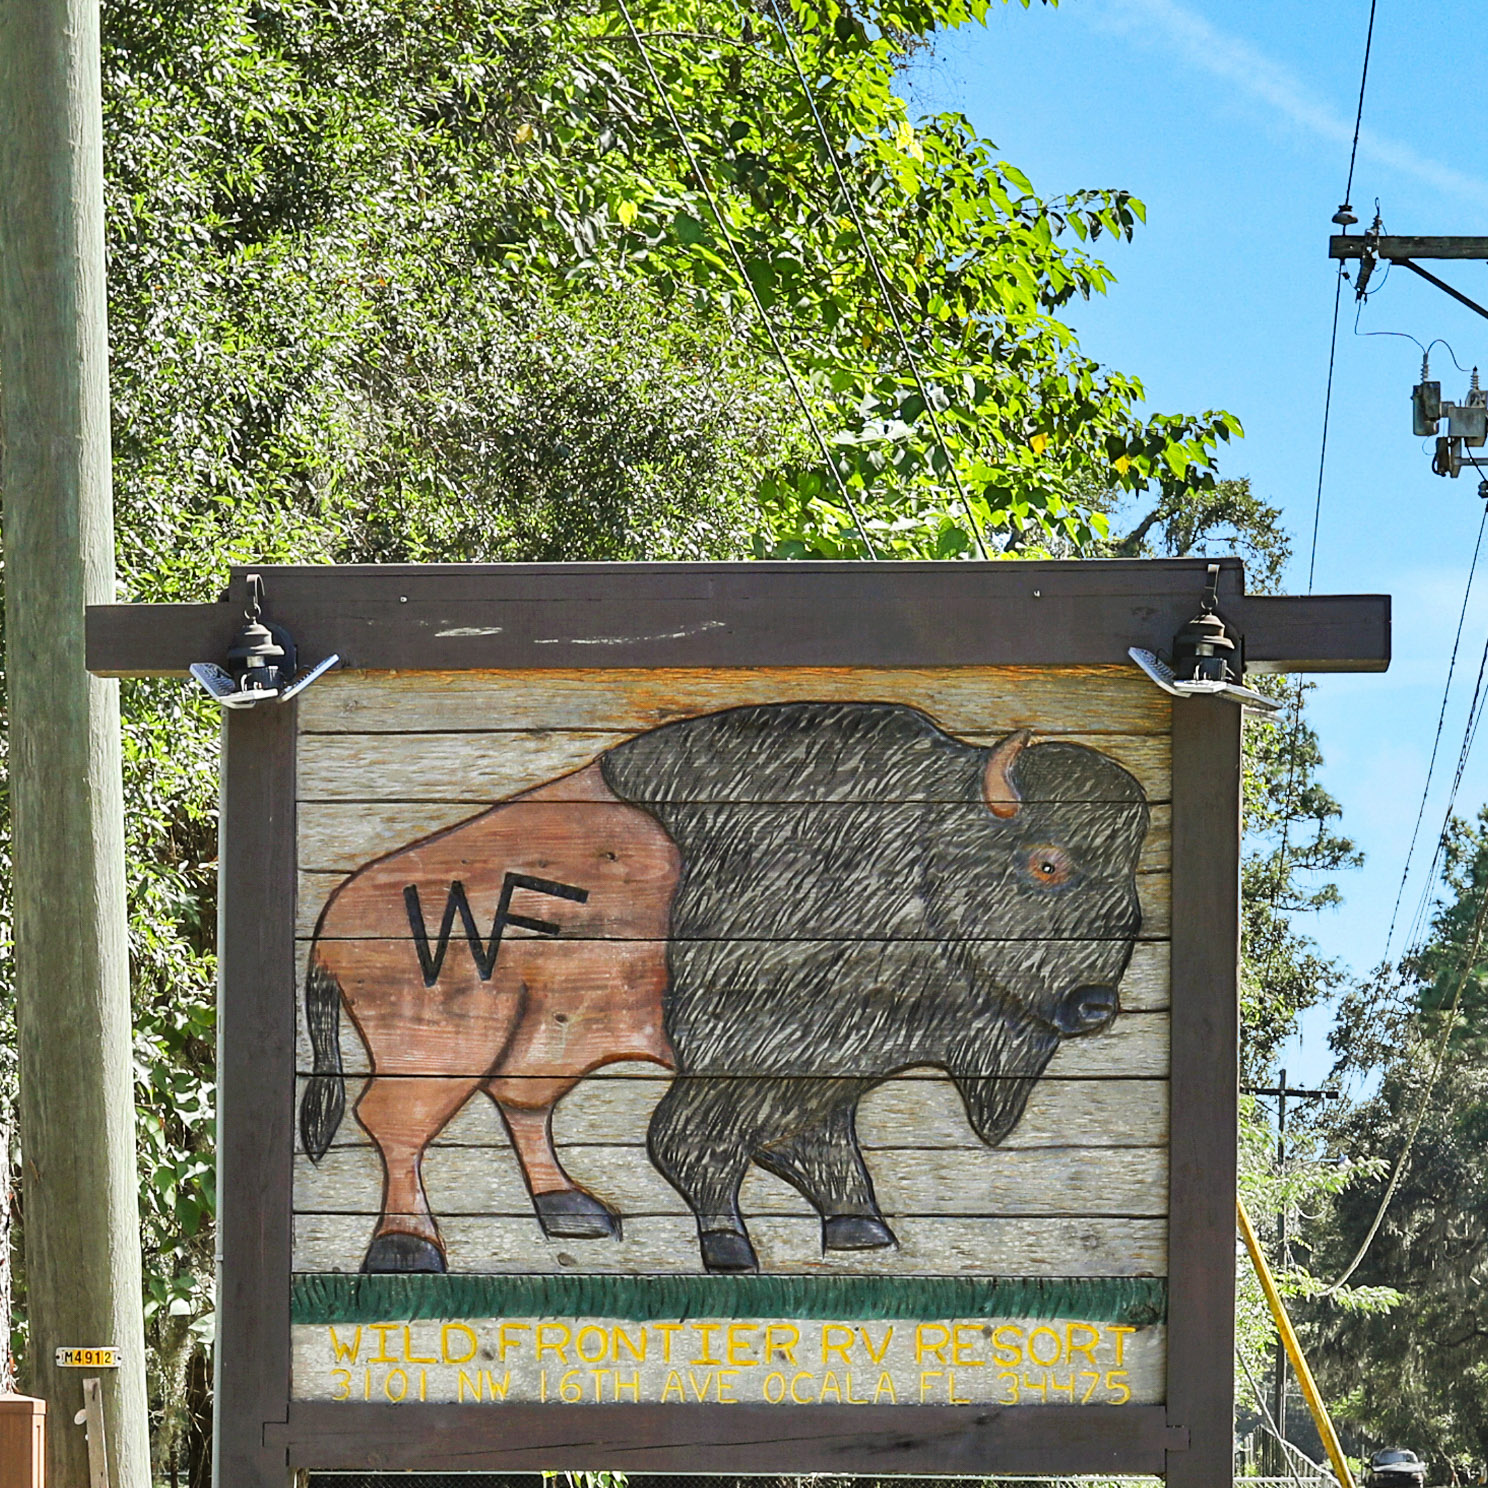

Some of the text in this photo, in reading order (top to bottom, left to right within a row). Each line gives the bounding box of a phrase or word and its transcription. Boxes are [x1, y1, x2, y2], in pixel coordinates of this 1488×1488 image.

[402, 871, 589, 987] WF
[65, 1351, 111, 1364] M4912
[329, 1323, 1137, 1367] WILD FRONTIER RV RESORT
[330, 1368, 1131, 1405] 3101 NW 16TH AVE OCALA FL 34475
